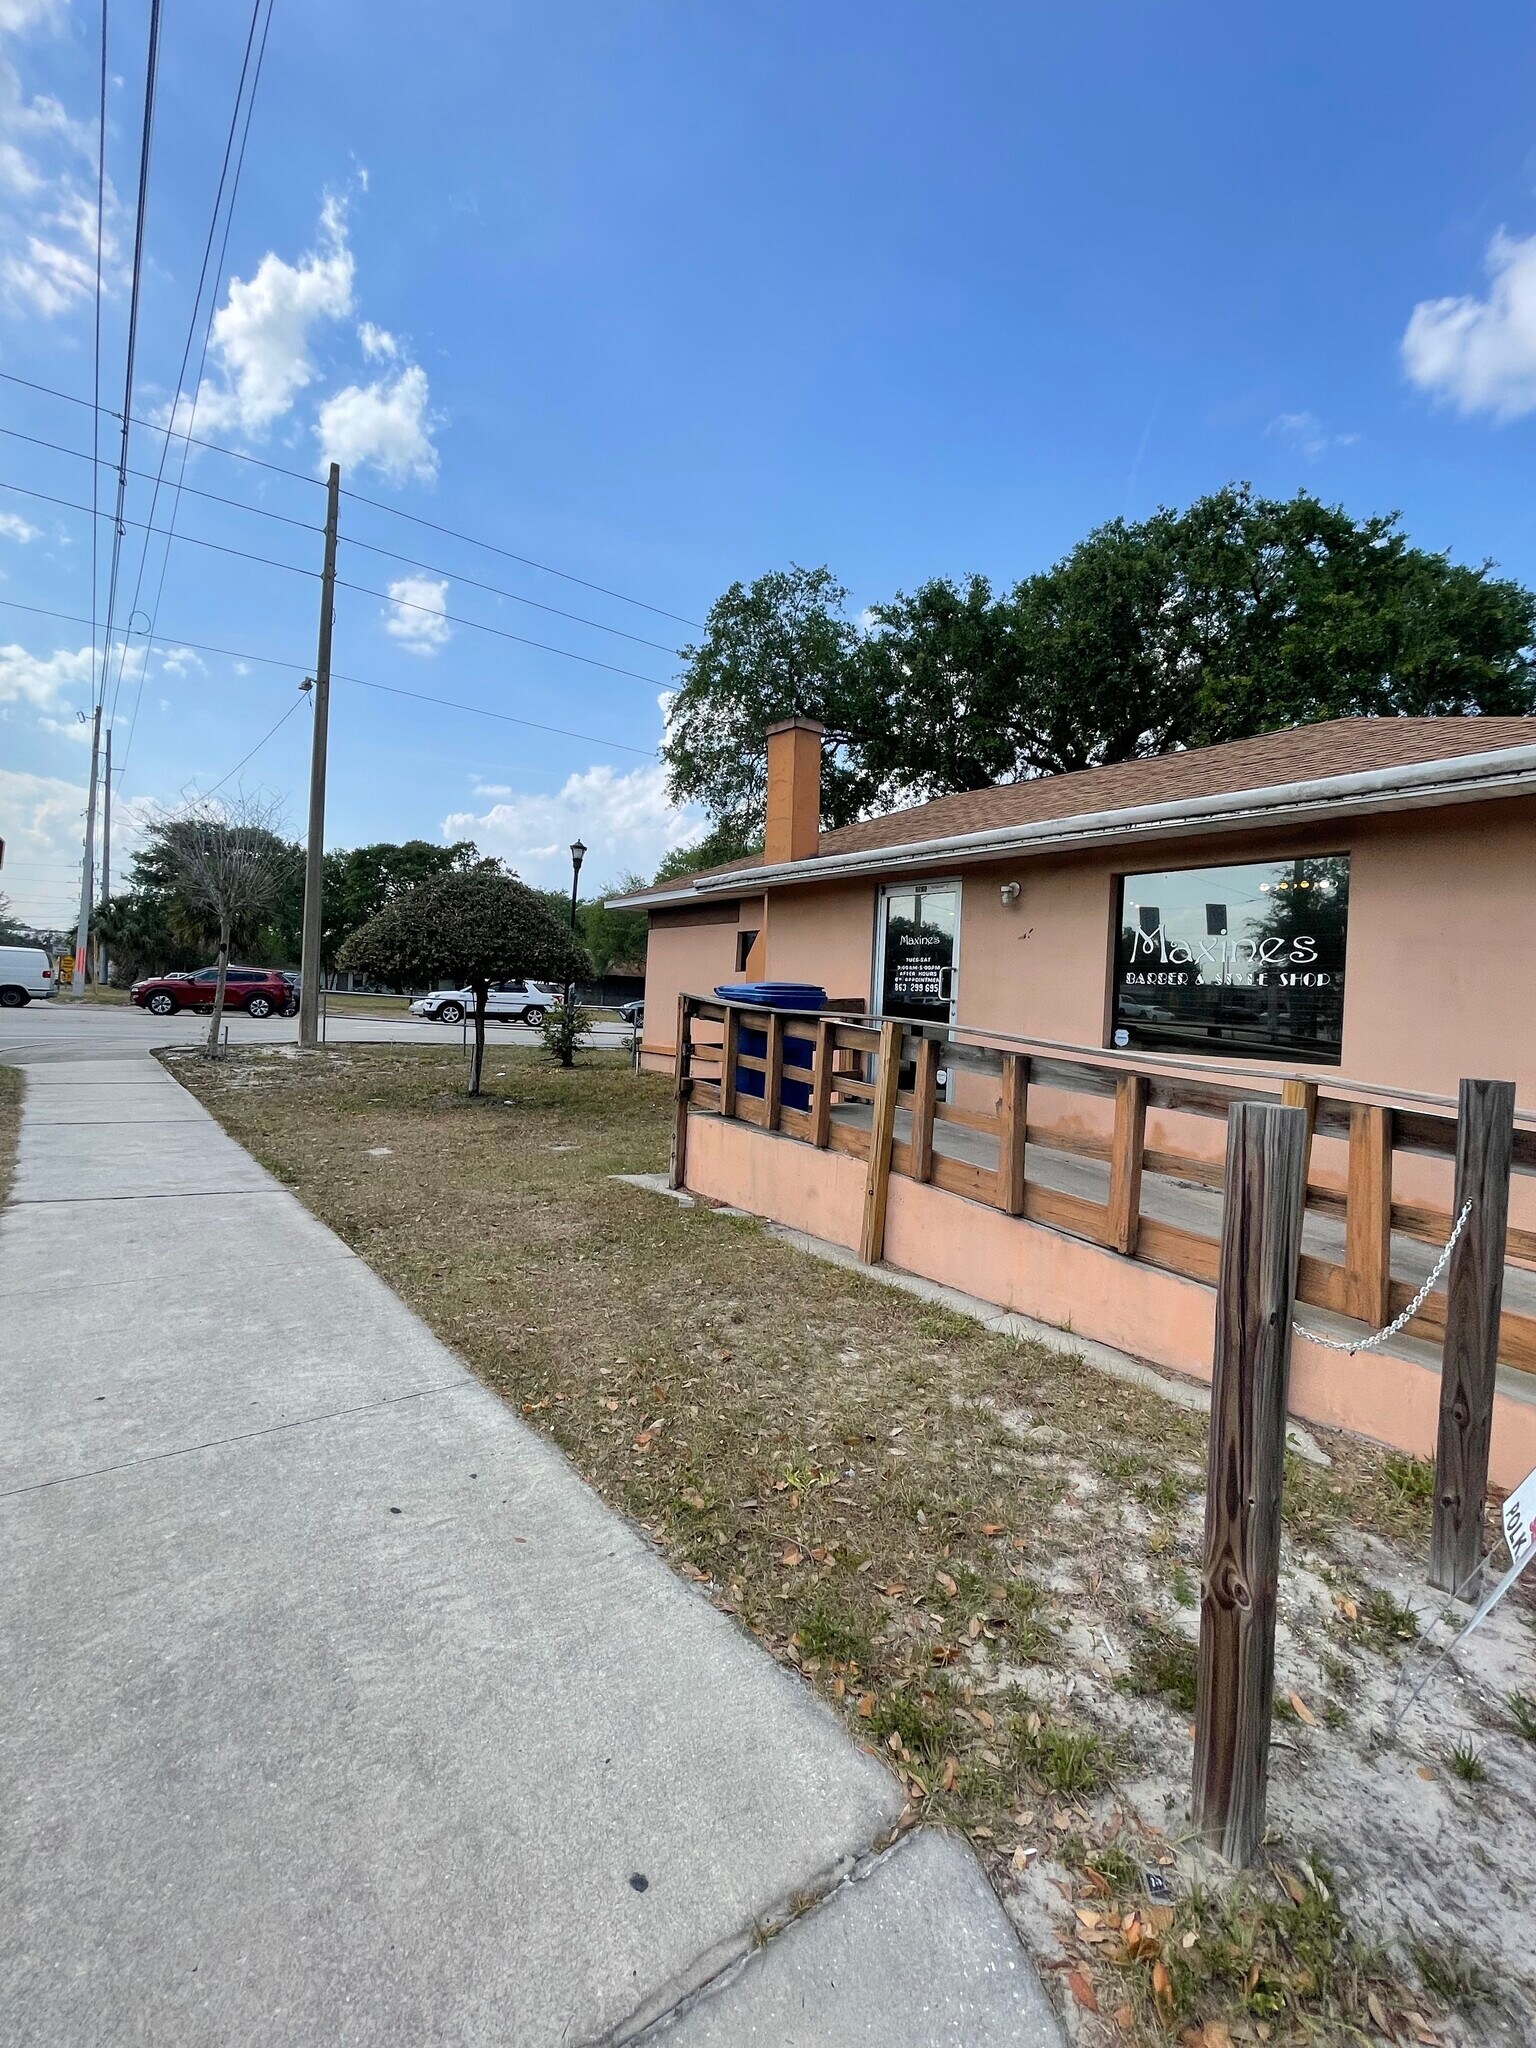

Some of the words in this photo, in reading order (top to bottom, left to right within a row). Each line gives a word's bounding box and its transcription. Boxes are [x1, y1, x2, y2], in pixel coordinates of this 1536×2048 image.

[1130, 924, 1318, 966] Maxines
[894, 983, 907, 992] 863
[910, 983, 924, 993] 299
[924, 984, 939, 993] 695
[1125, 972, 1189, 986] BARBER
[1194, 973, 1205, 986] &
[1214, 973, 1269, 987] STYLE
[1278, 972, 1331, 987] SHOP
[1505, 1501, 1528, 1560] POLK
